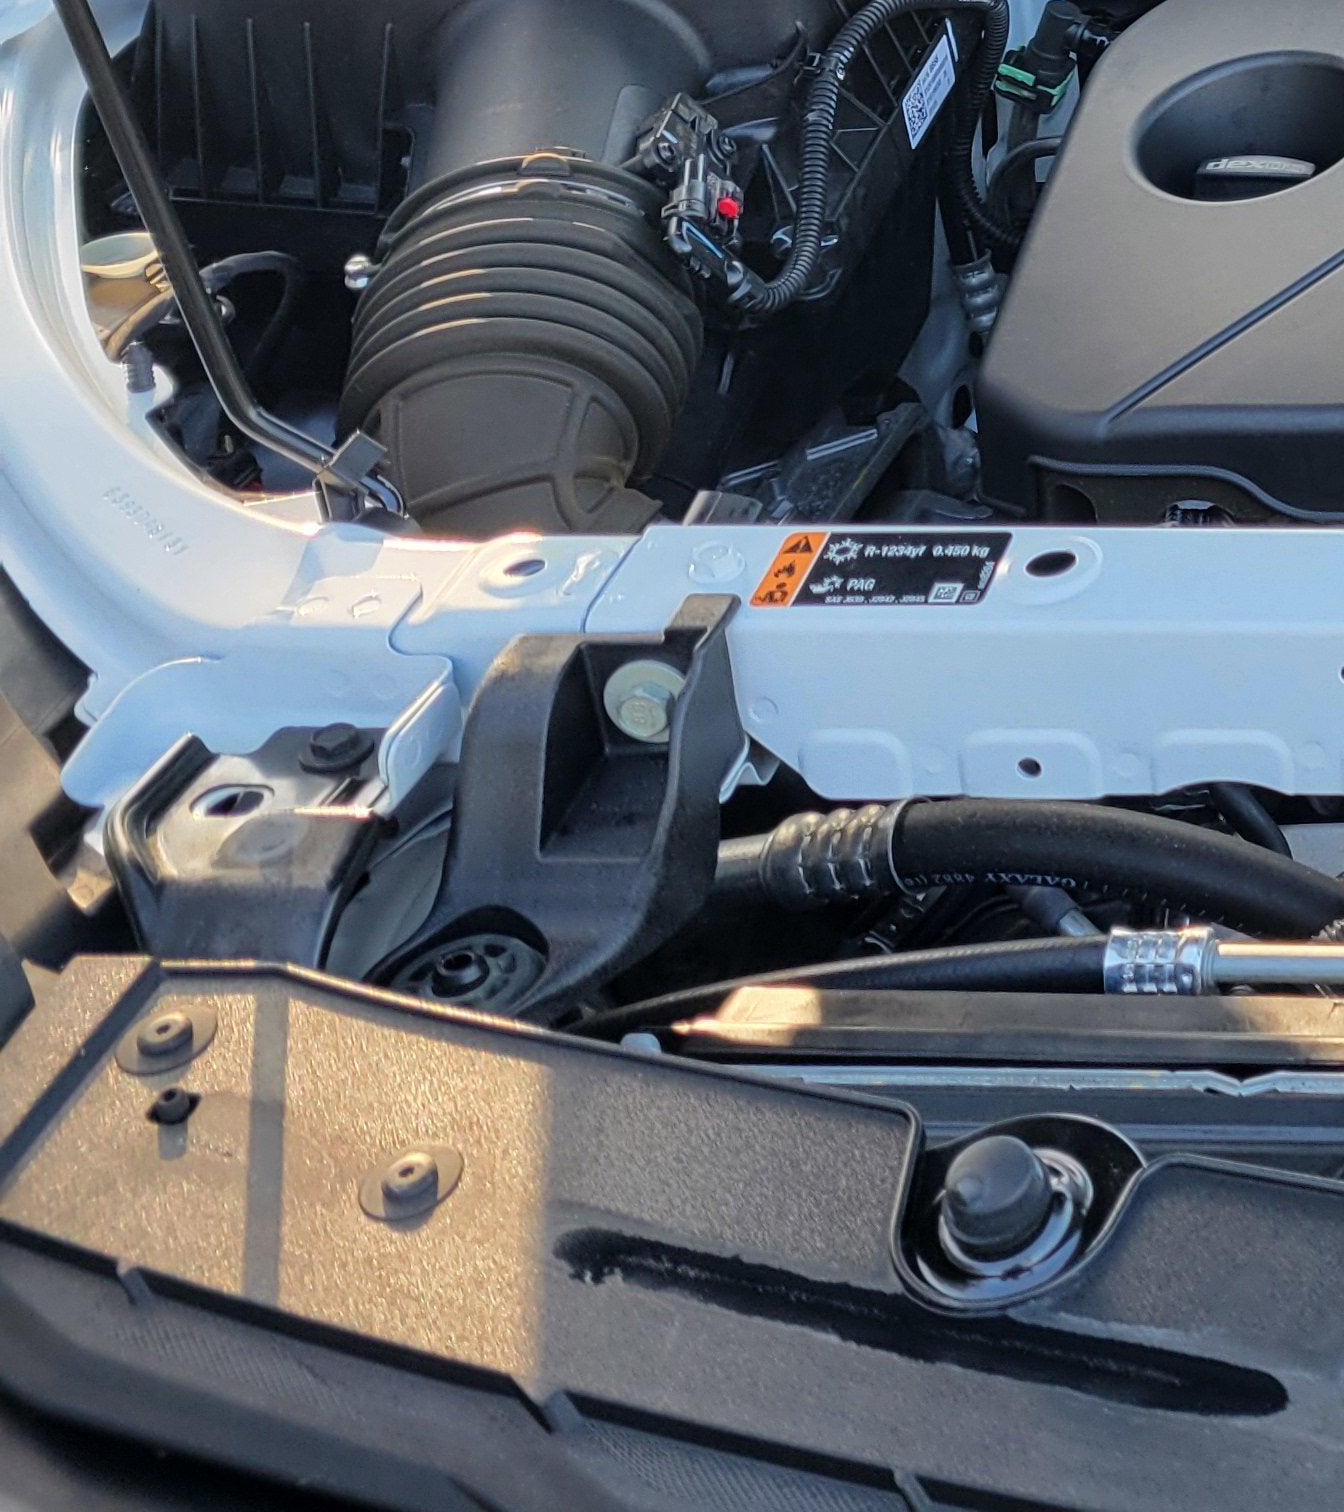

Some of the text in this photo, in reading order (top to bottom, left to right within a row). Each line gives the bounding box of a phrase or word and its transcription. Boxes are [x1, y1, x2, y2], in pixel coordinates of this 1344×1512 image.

[864, 544, 926, 558] R-1234yf
[971, 544, 990, 559] kg
[846, 577, 876, 591] PAG
[985, 872, 1077, 888] GALAXY
